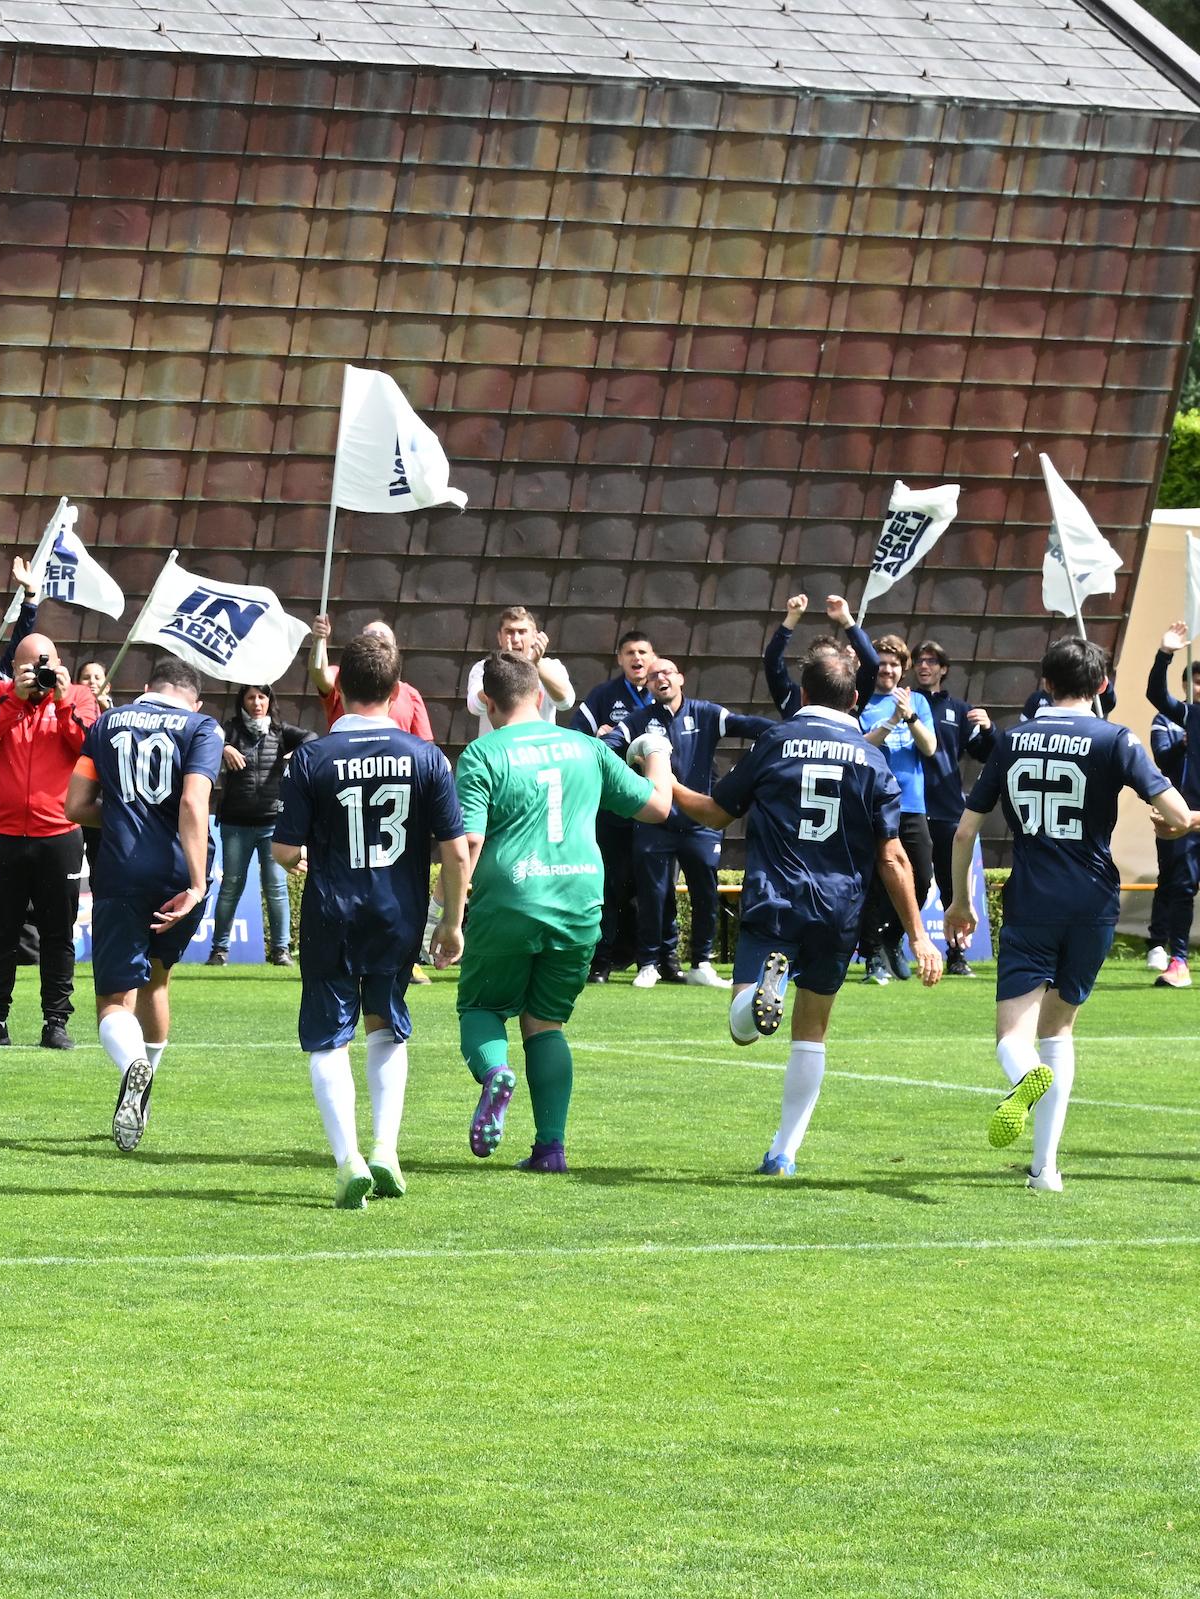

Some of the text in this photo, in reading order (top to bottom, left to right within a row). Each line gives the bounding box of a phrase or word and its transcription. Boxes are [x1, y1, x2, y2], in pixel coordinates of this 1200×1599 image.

[176, 590, 265, 641] IN
[163, 618, 233, 661] ABILI
[107, 710, 188, 731] MANGIAFICO
[1011, 732, 1092, 756] TRALONGO
[110, 731, 175, 805] 10
[334, 756, 412, 780] TROINA
[506, 742, 583, 766] LANTERI
[782, 739, 854, 762] OCCHIPINTI
[537, 768, 563, 843] 1
[798, 764, 843, 842] 5
[1007, 758, 1087, 840] 62
[336, 784, 411, 869] 13
